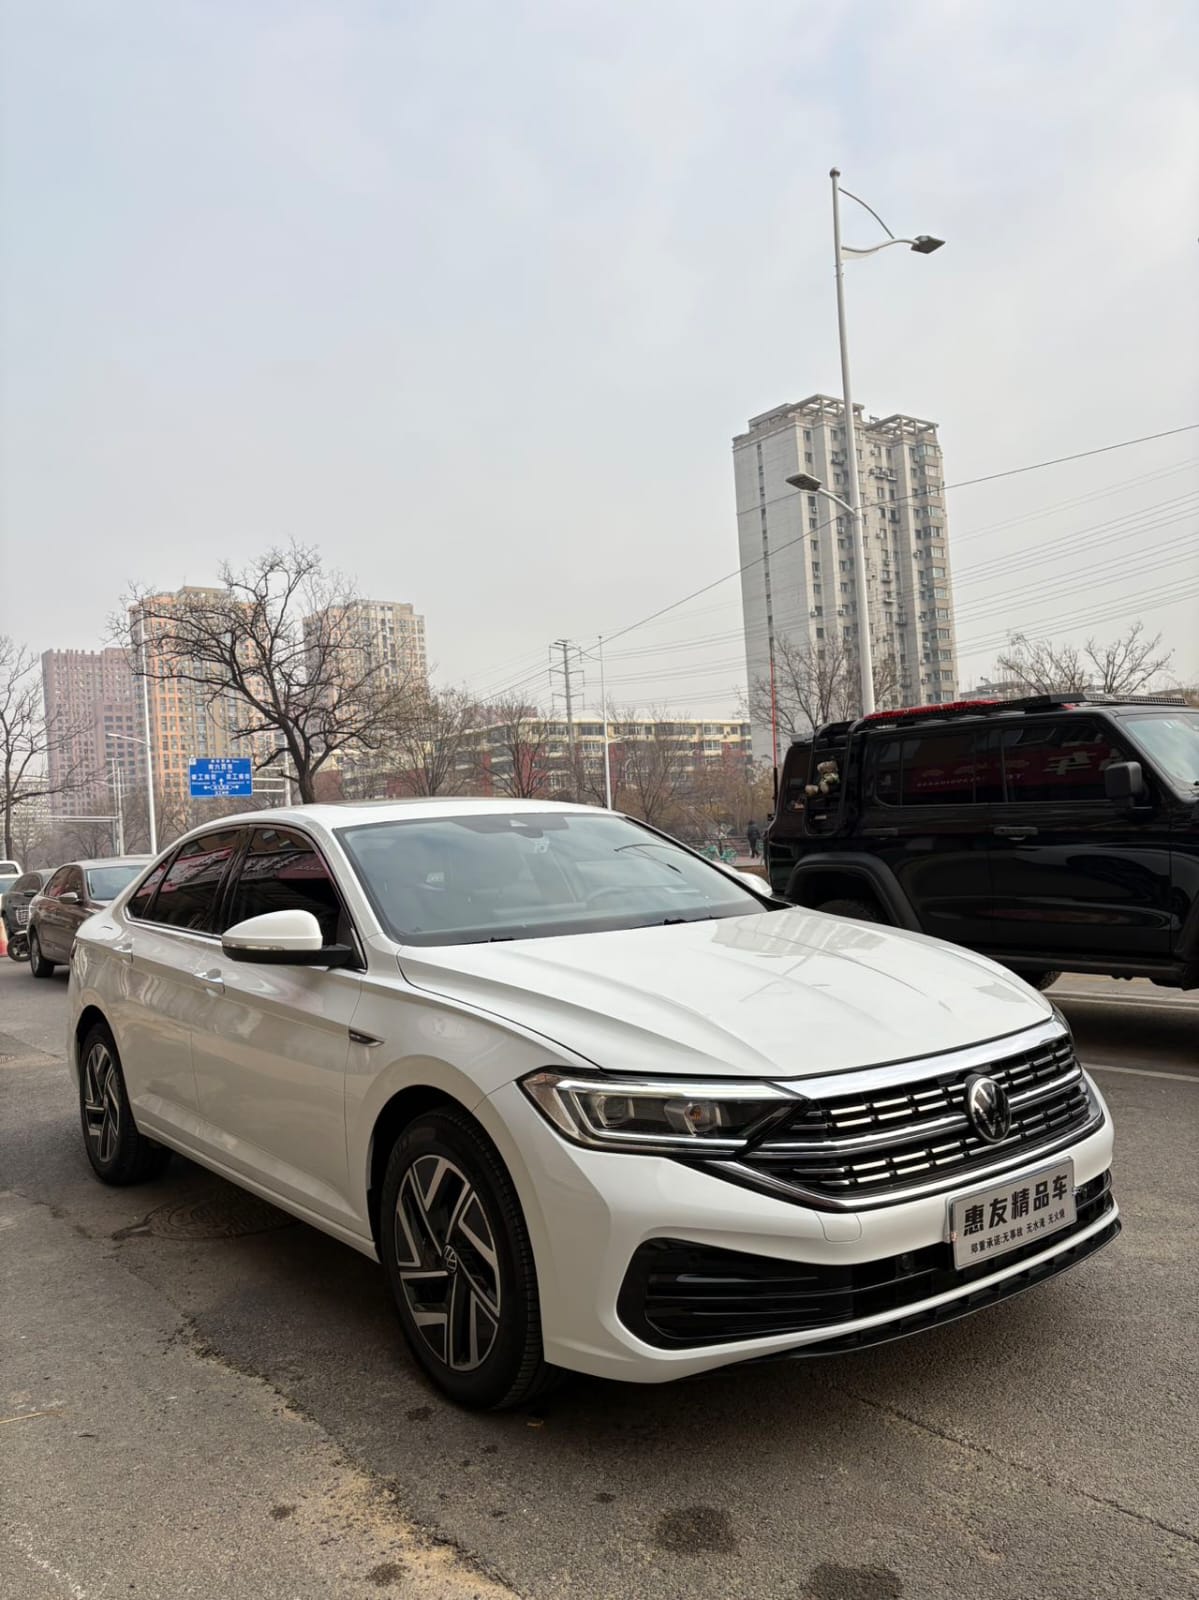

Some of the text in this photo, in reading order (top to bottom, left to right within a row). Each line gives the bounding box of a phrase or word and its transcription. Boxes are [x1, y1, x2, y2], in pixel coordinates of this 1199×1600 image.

[963, 1174, 1068, 1236] 惠友精品车
